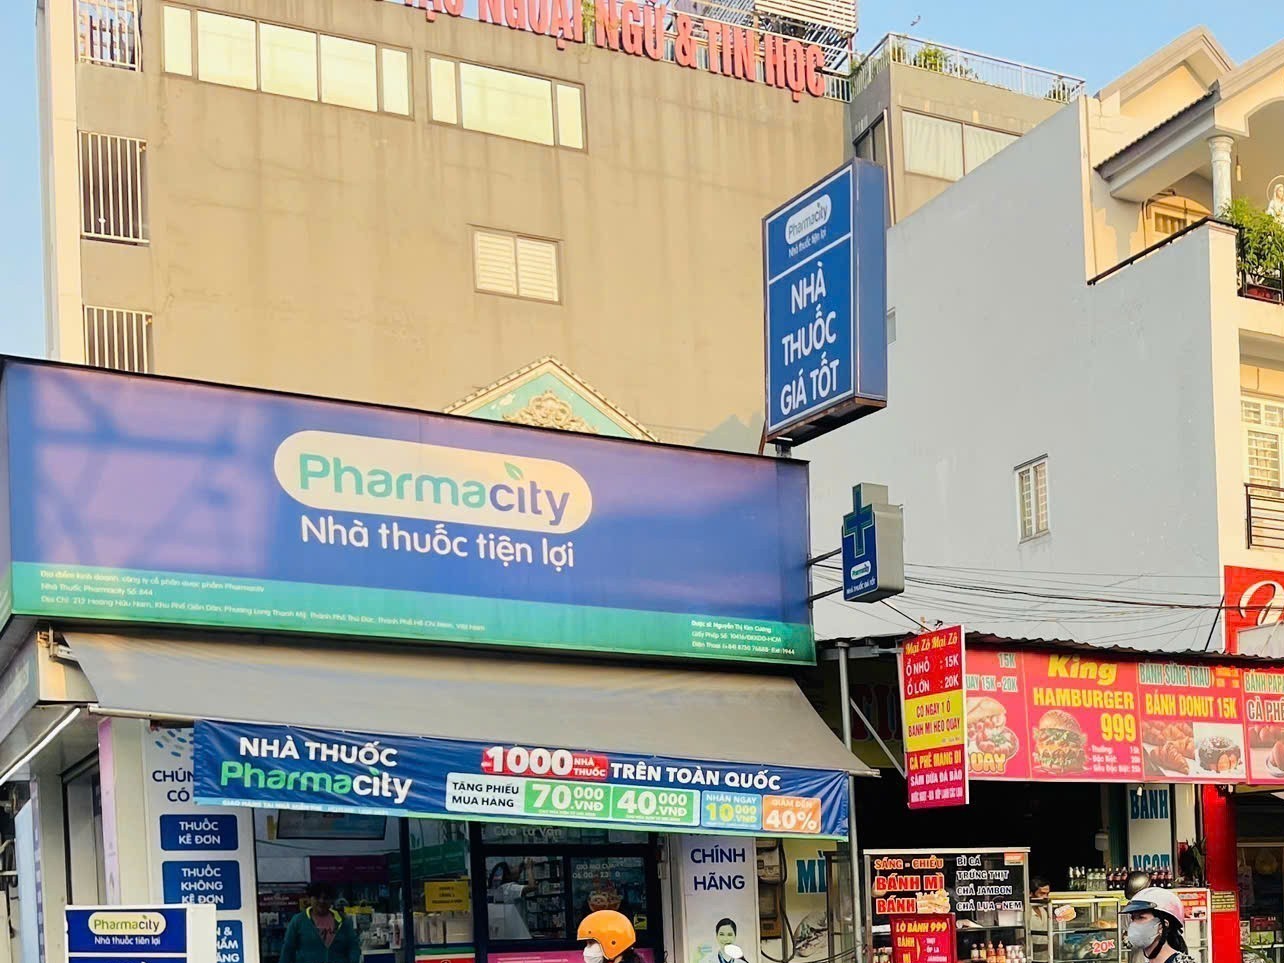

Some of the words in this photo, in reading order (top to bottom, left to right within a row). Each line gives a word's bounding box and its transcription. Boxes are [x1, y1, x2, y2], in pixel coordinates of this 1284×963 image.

[675, 14, 696, 68] &
[703, 20, 756, 82] TIN
[764, 33, 826, 102] HỌC
[791, 260, 827, 314] NHÀ
[781, 303, 837, 366] THUỐC
[780, 369, 808, 416] GIÁ
[810, 352, 840, 400] TỐT
[299, 453, 570, 526] Pharmacity
[301, 514, 369, 548] Nhà
[378, 522, 469, 556] thuốc
[476, 532, 532, 567] tiện
[542, 537, 574, 572] lợi
[914, 656, 930, 673] NHỎ
[945, 655, 959, 668] 15K
[998, 653, 1017, 669] 15K
[1048, 654, 1118, 686] King
[1139, 660, 1163, 685] BÁNH
[1245, 669, 1266, 694] BÁNH
[914, 681, 930, 694] LỚN
[945, 675, 959, 689] 20K
[981, 676, 997, 692] 15K
[1002, 677, 1018, 693] 20K
[1033, 687, 1135, 710] HAMBURGER
[1145, 689, 1176, 715] BÁNH
[1179, 694, 1214, 717] DONUT
[1217, 697, 1237, 719] 15K
[1247, 696, 1264, 721] CÀ
[1100, 713, 1137, 742] 999
[239, 734, 300, 760] NHÀ
[305, 740, 399, 768] THUỐC
[485, 745, 573, 776] 1000
[574, 755, 595, 767] NHÀ
[152, 768, 195, 783] CHÚN
[573, 765, 607, 779] THUỐC
[611, 759, 662, 783] TRÊN
[666, 762, 720, 787] TOÀN
[723, 768, 782, 792] QUỐC
[219, 760, 413, 804] Pharmacity
[451, 780, 483, 797] TẶNG
[485, 781, 520, 796] PHIẾU
[167, 786, 190, 802] CÓ
[451, 795, 476, 807] MUA
[478, 795, 514, 809] HÀNG
[531, 783, 571, 809] 70
[574, 786, 603, 800] 000
[617, 789, 656, 815] 40
[658, 793, 687, 806] 000
[733, 795, 757, 804] NGAY
[705, 804, 733, 820] 10
[766, 809, 818, 831] 40%
[179, 817, 219, 831] THUỐC
[178, 832, 192, 844] KÊ
[194, 834, 220, 844] ĐƠN
[690, 844, 746, 864] CHÍNH
[874, 855, 903, 869] SÁNG
[912, 855, 943, 869] CHIỀU
[956, 854, 967, 867] BÌ
[181, 864, 221, 877] THUỐC
[957, 869, 987, 881] TRỨNG
[988, 870, 1010, 881] THỊT
[181, 878, 223, 891] KHÔNG
[693, 871, 745, 891] HÃNG
[876, 872, 920, 891] BÁNH
[923, 872, 945, 890] MÌ
[956, 883, 975, 896] CHẢ
[977, 885, 1012, 895] JAMBON
[197, 894, 224, 904] ĐƠN
[876, 893, 916, 914] BÁNH
[956, 898, 975, 911] CHẢ
[977, 901, 995, 912] LỤA
[1003, 901, 1023, 912] NEM
[94, 915, 160, 933] Pharmacity
[907, 920, 928, 933] BÁNH
[930, 922, 947, 932] 999
[94, 935, 111, 945] Nhà
[112, 935, 134, 946] thuốc
[151, 936, 161, 947] lợi
[1092, 938, 1115, 954] 20K
